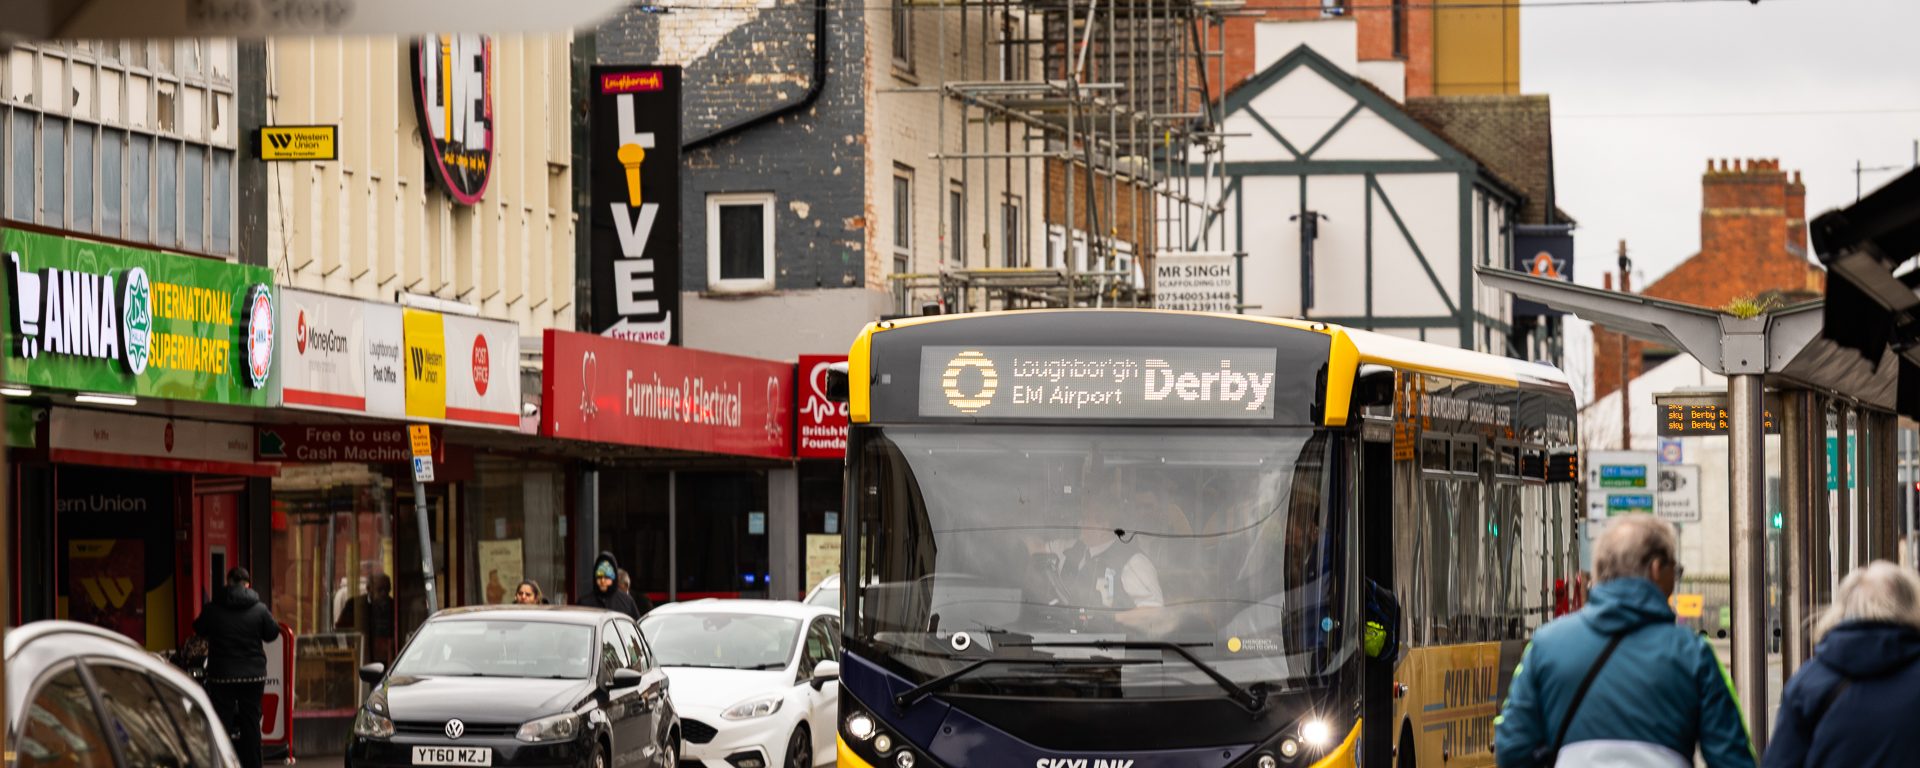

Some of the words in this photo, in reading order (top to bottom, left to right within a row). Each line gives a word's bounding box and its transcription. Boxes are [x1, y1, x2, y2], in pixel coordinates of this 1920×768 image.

[604, 73, 660, 91] Loughborough
[294, 132, 329, 141] Western
[294, 141, 319, 150] Union
[1158, 266, 1181, 278] MR
[1185, 265, 1231, 277] SINGH
[1158, 280, 1214, 288] SCAFFOLDING
[1216, 279, 1231, 287] LTD
[150, 281, 233, 327] NTERNATIONAL
[44, 267, 119, 360] ANNA
[308, 327, 349, 358] MoneyGram
[611, 329, 665, 342] Entrance
[148, 332, 231, 375] SUPERMARKET
[368, 340, 399, 362] Loughborough
[424, 348, 443, 366] Western
[475, 347, 487, 364] POST
[373, 364, 383, 381] Post
[384, 366, 397, 384] Office
[424, 363, 438, 384] Union
[474, 366, 488, 384] OFFICE
[1144, 359, 1275, 411] Derby
[626, 369, 680, 421] Furniture
[682, 376, 691, 423] &
[693, 377, 741, 428] Electrical
[1013, 386, 1042, 404] EM
[1049, 386, 1122, 409] Airport
[1669, 411, 1683, 420] sky
[802, 425, 838, 436] British
[1669, 421, 1683, 430] sky
[306, 427, 341, 442] Free
[350, 427, 365, 442] to
[373, 430, 401, 442] use
[802, 437, 847, 449] Founda
[297, 446, 336, 460] Cash
[90, 495, 147, 512] Union
[419, 748, 454, 762] YT60
[459, 749, 486, 763] MZJ
